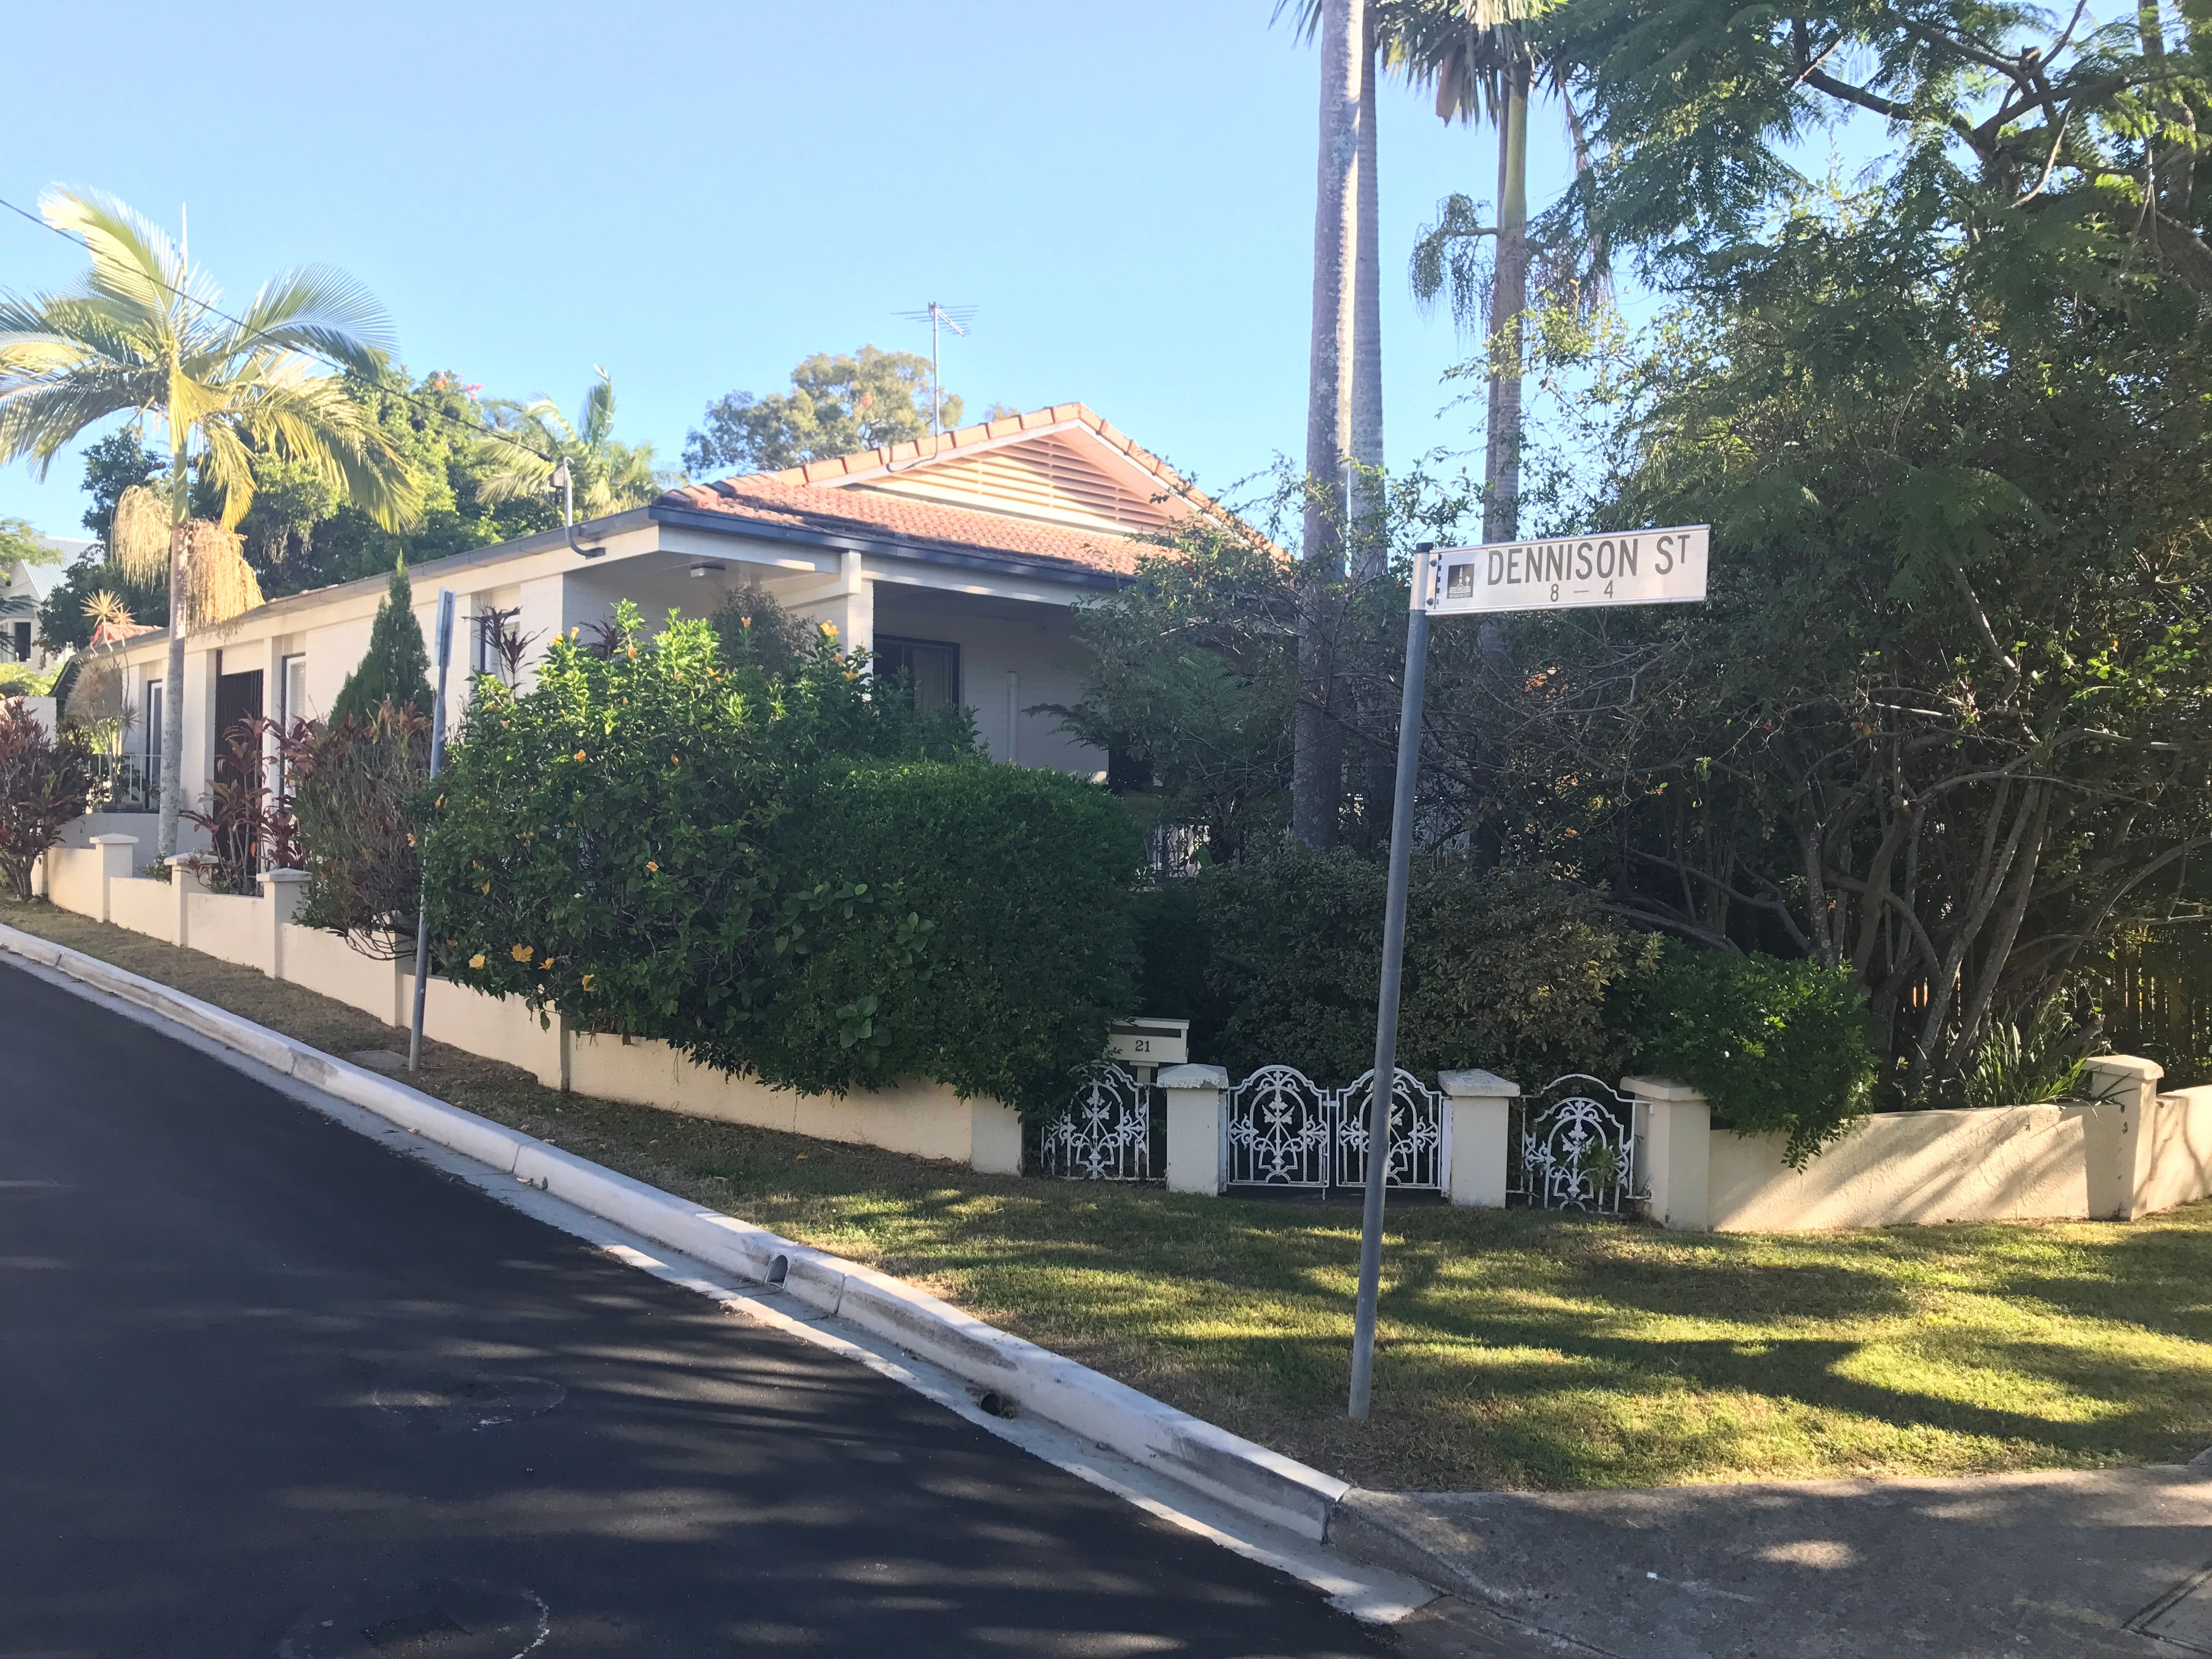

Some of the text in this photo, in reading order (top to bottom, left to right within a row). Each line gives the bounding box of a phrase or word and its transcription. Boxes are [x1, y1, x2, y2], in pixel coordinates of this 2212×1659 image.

[1487, 534, 1690, 585] DENNISON ST
[1550, 583, 1559, 602] 8
[1603, 579, 1613, 599] 4
[1135, 1040, 1150, 1052] 21
